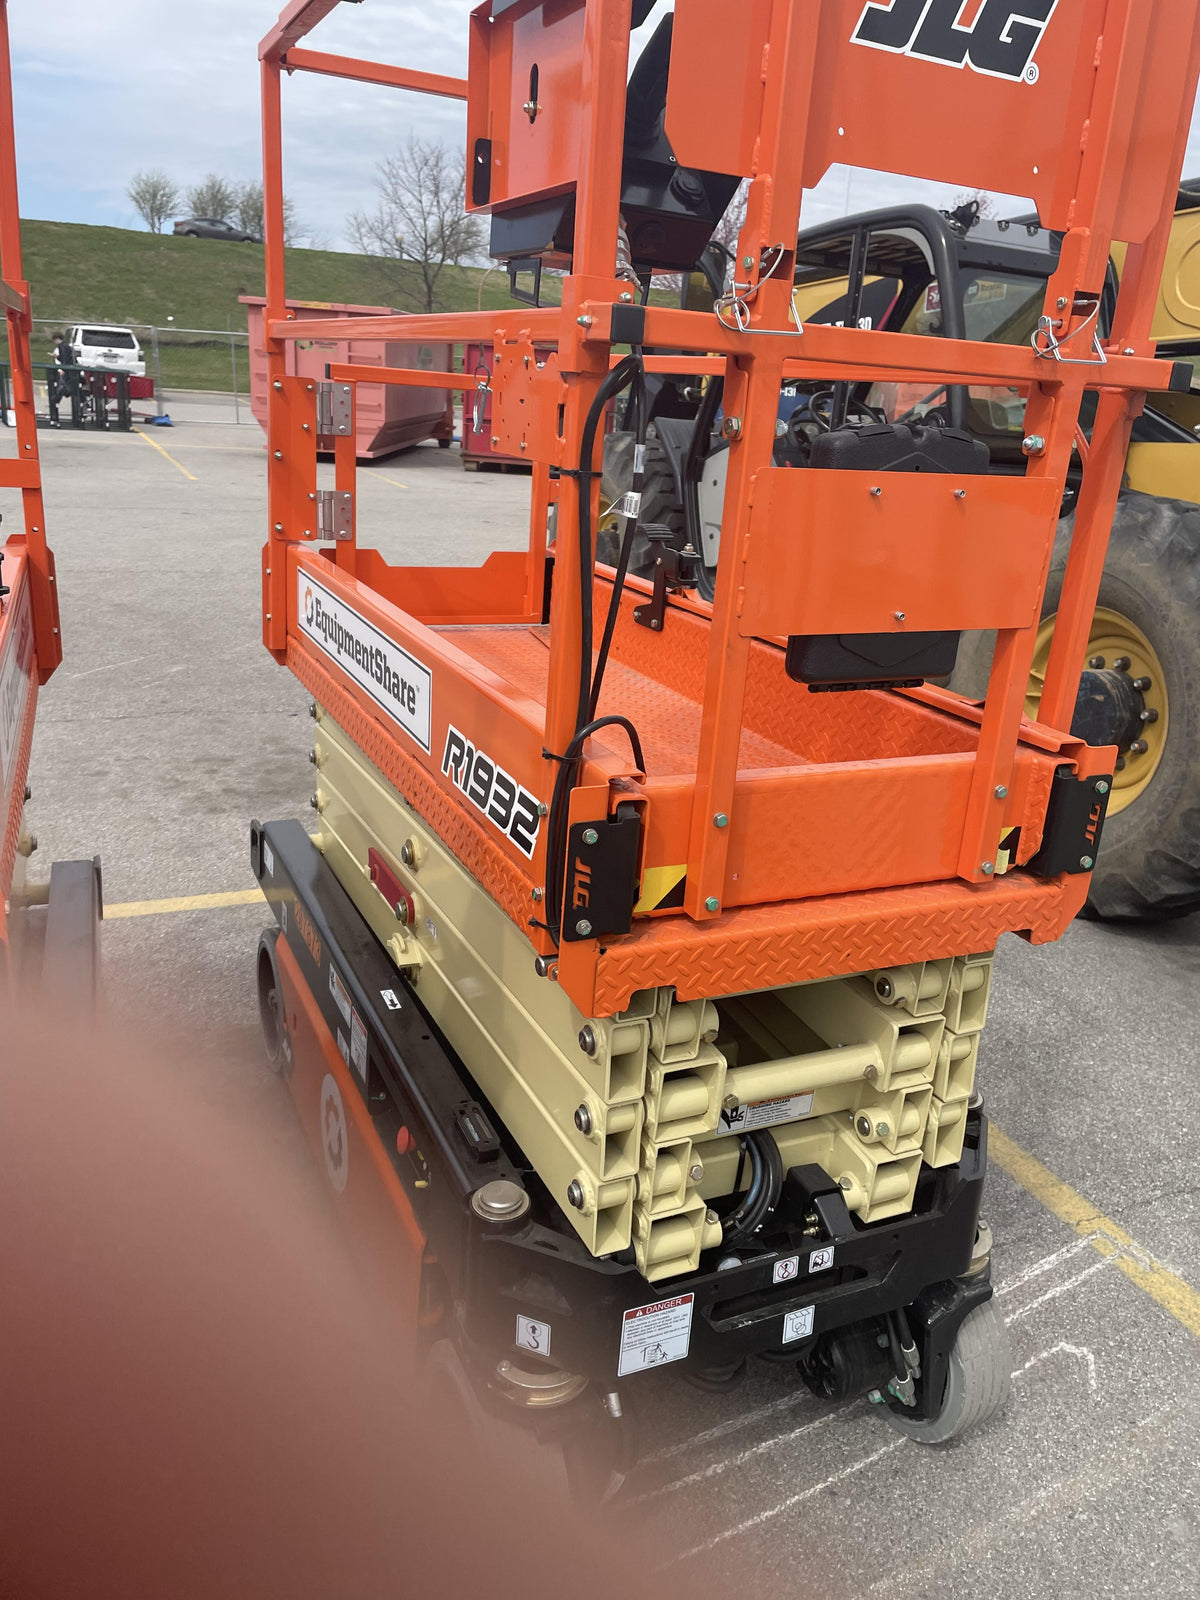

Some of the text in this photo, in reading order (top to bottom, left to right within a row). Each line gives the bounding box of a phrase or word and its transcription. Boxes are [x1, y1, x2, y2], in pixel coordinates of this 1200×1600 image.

[315, 597, 416, 716] EquipmentShare
[442, 724, 540, 861] R1932
[1085, 804, 1101, 845] JLG
[572, 856, 592, 910] JLG
[645, 1298, 682, 1314] DANGER
